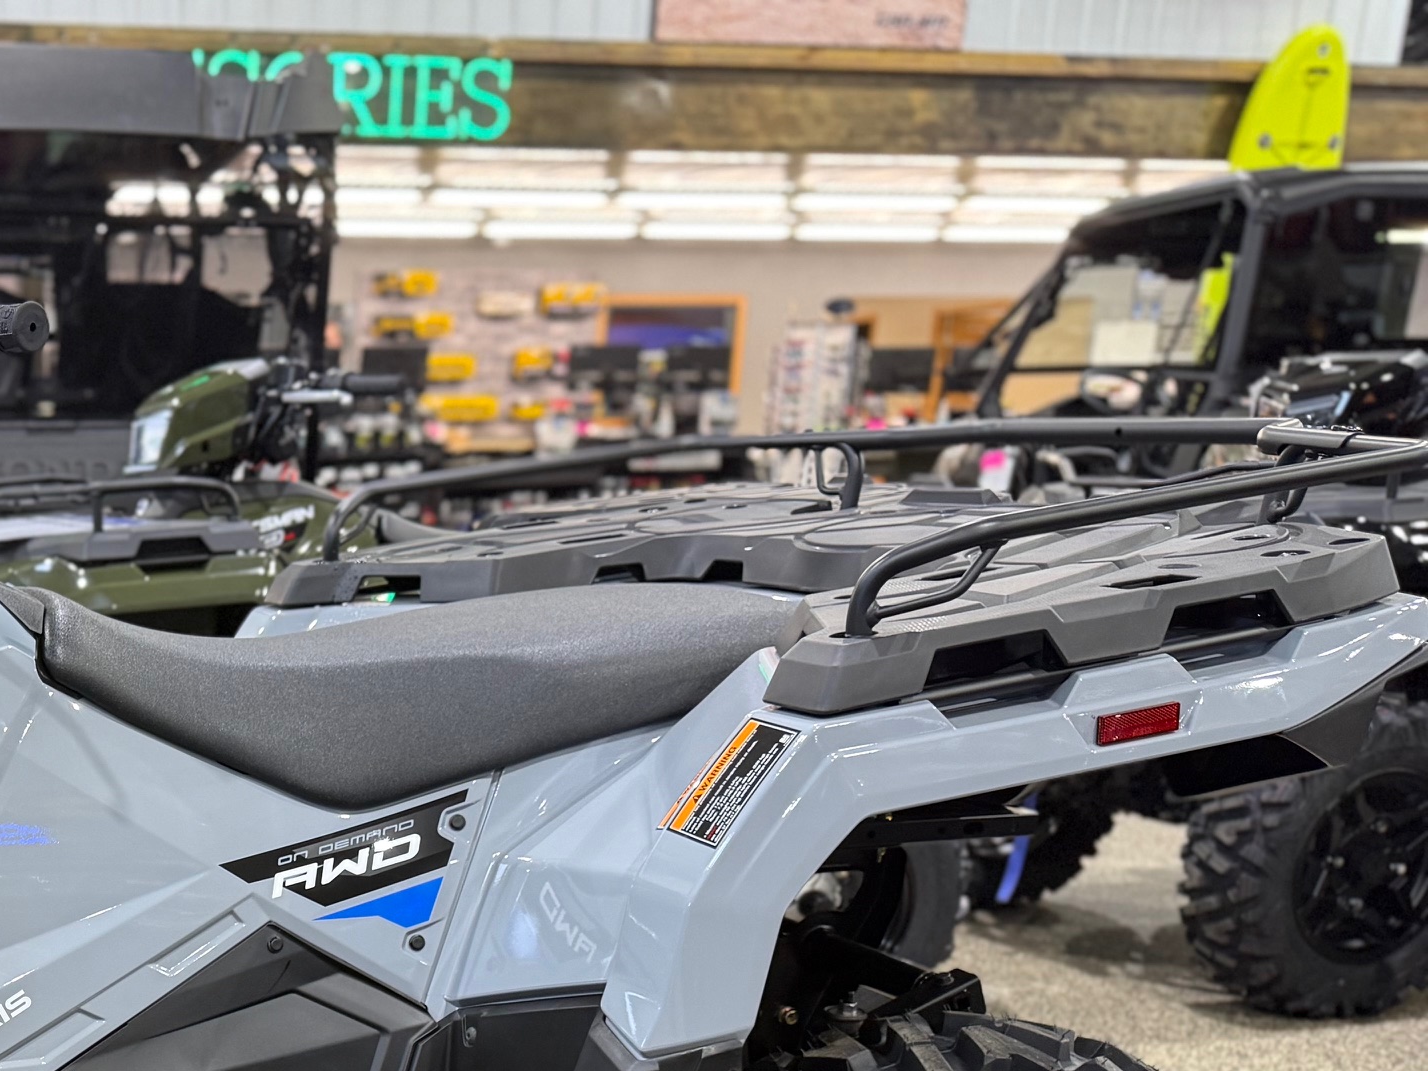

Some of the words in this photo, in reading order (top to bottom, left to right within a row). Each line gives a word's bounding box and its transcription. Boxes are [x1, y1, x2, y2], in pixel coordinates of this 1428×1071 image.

[698, 746, 737, 792] WARNING
[278, 850, 309, 866] ON
[318, 818, 415, 856] DEMAND
[272, 833, 421, 900] AWD
